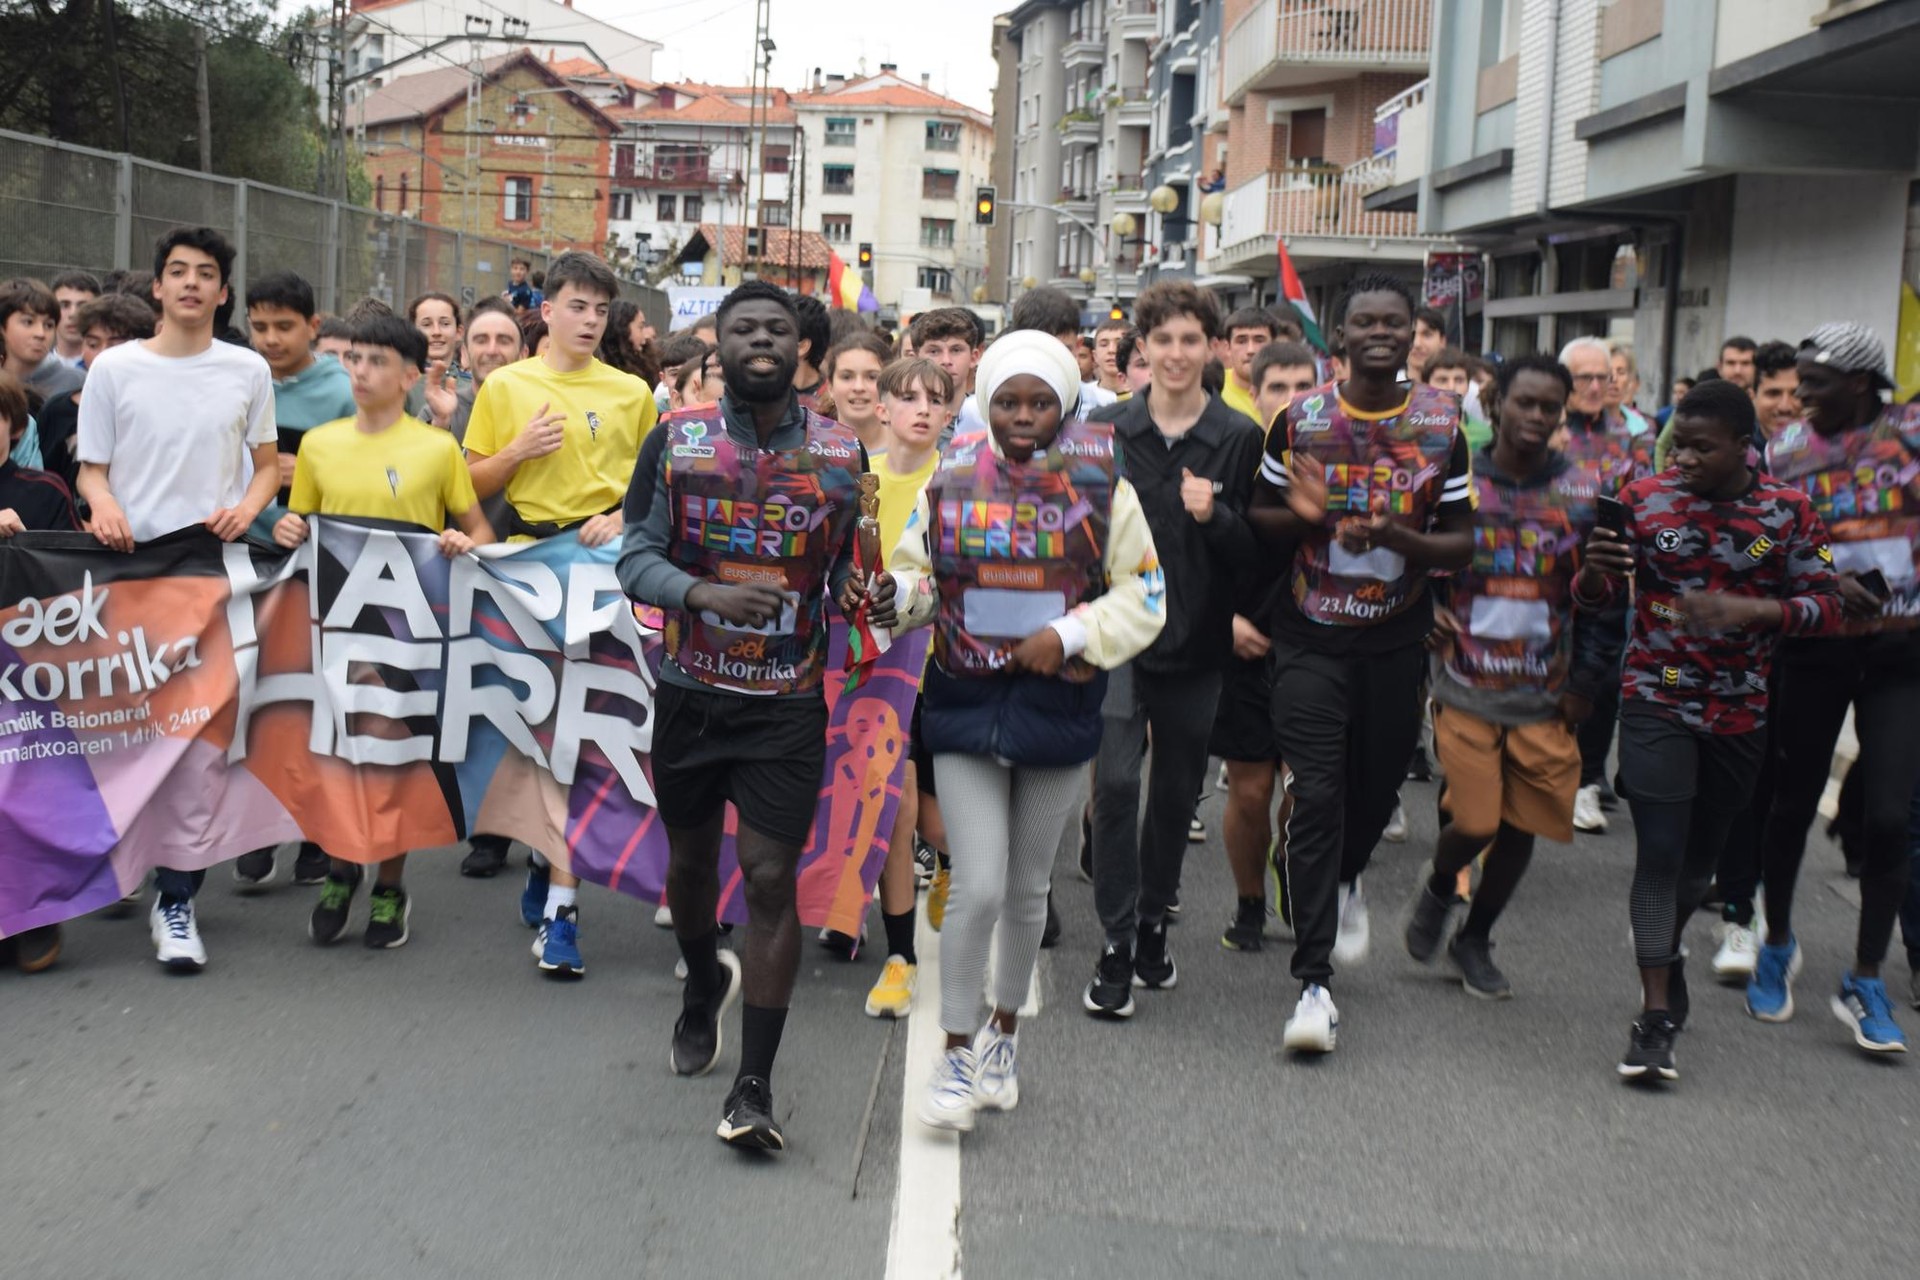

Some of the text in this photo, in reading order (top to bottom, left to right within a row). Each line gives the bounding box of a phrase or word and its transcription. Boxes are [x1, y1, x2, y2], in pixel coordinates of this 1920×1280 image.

[823, 445, 851, 459] eitb
[2, 569, 110, 648] aek
[222, 514, 656, 692] HARR
[728, 635, 766, 661] aek
[0, 736, 113, 765] martxoaren
[169, 705, 212, 733] 24ra
[51, 701, 151, 730] Baionarat
[227, 624, 656, 808] HERR
